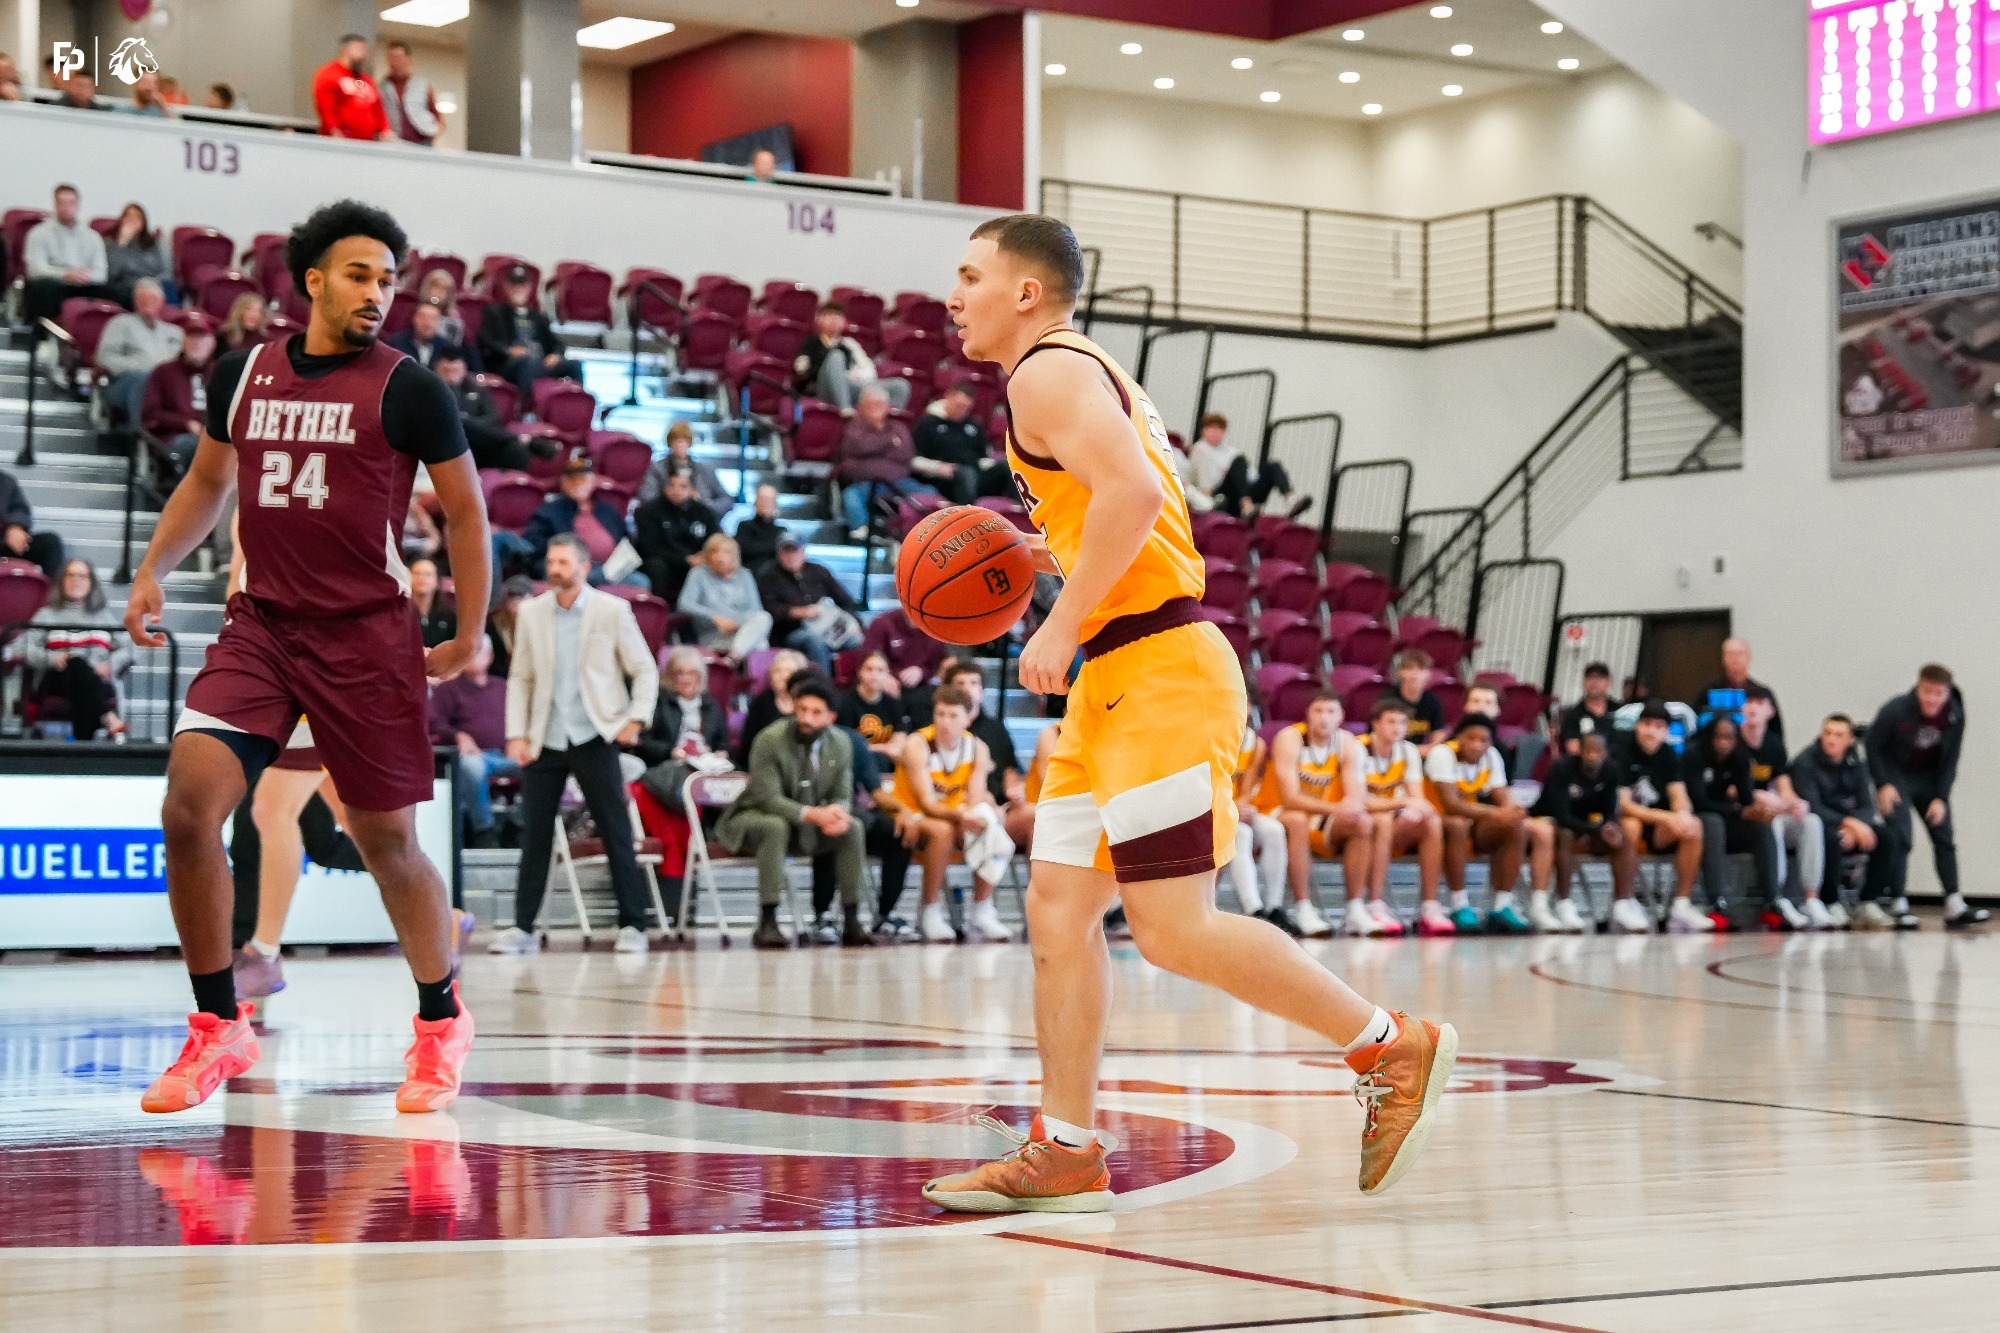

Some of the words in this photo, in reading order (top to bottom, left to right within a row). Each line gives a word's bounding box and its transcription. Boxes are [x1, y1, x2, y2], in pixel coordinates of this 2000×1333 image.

[184, 140, 239, 174] 103
[788, 202, 834, 234] 104
[245, 399, 357, 444] BETHEL
[258, 451, 329, 509] 24
[928, 516, 1013, 570] SPALDING
[0, 843, 167, 880] UELLER
